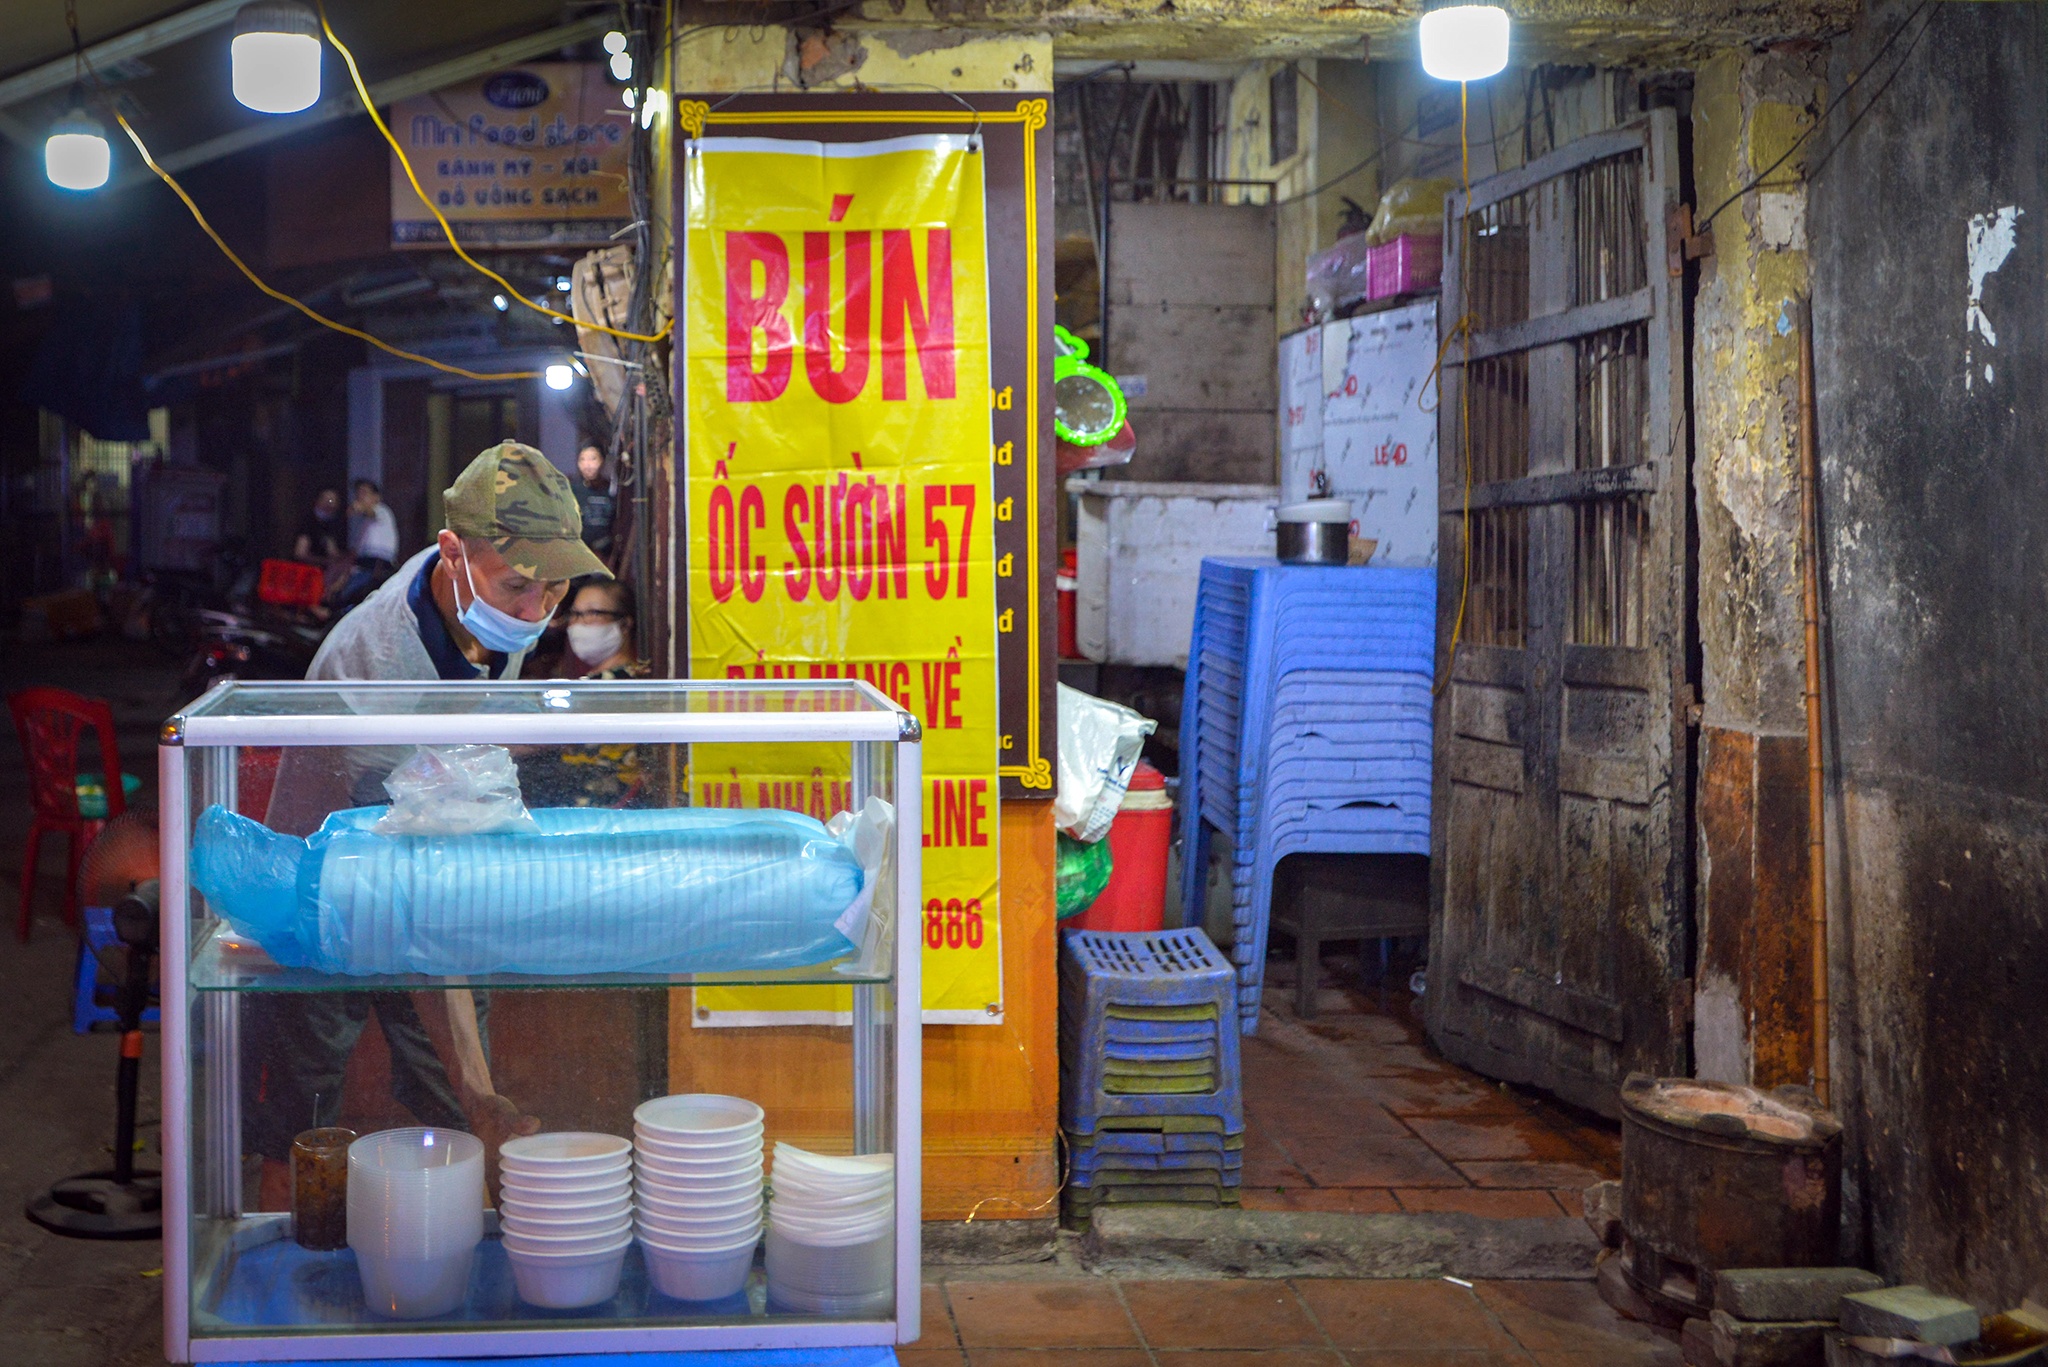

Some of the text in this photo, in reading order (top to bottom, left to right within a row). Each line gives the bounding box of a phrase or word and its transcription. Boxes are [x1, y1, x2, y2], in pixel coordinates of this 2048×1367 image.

[725, 193, 957, 405] BÚN
[708, 442, 976, 604] ỐC SƯỜN 57
[922, 636, 963, 729] VỀ
